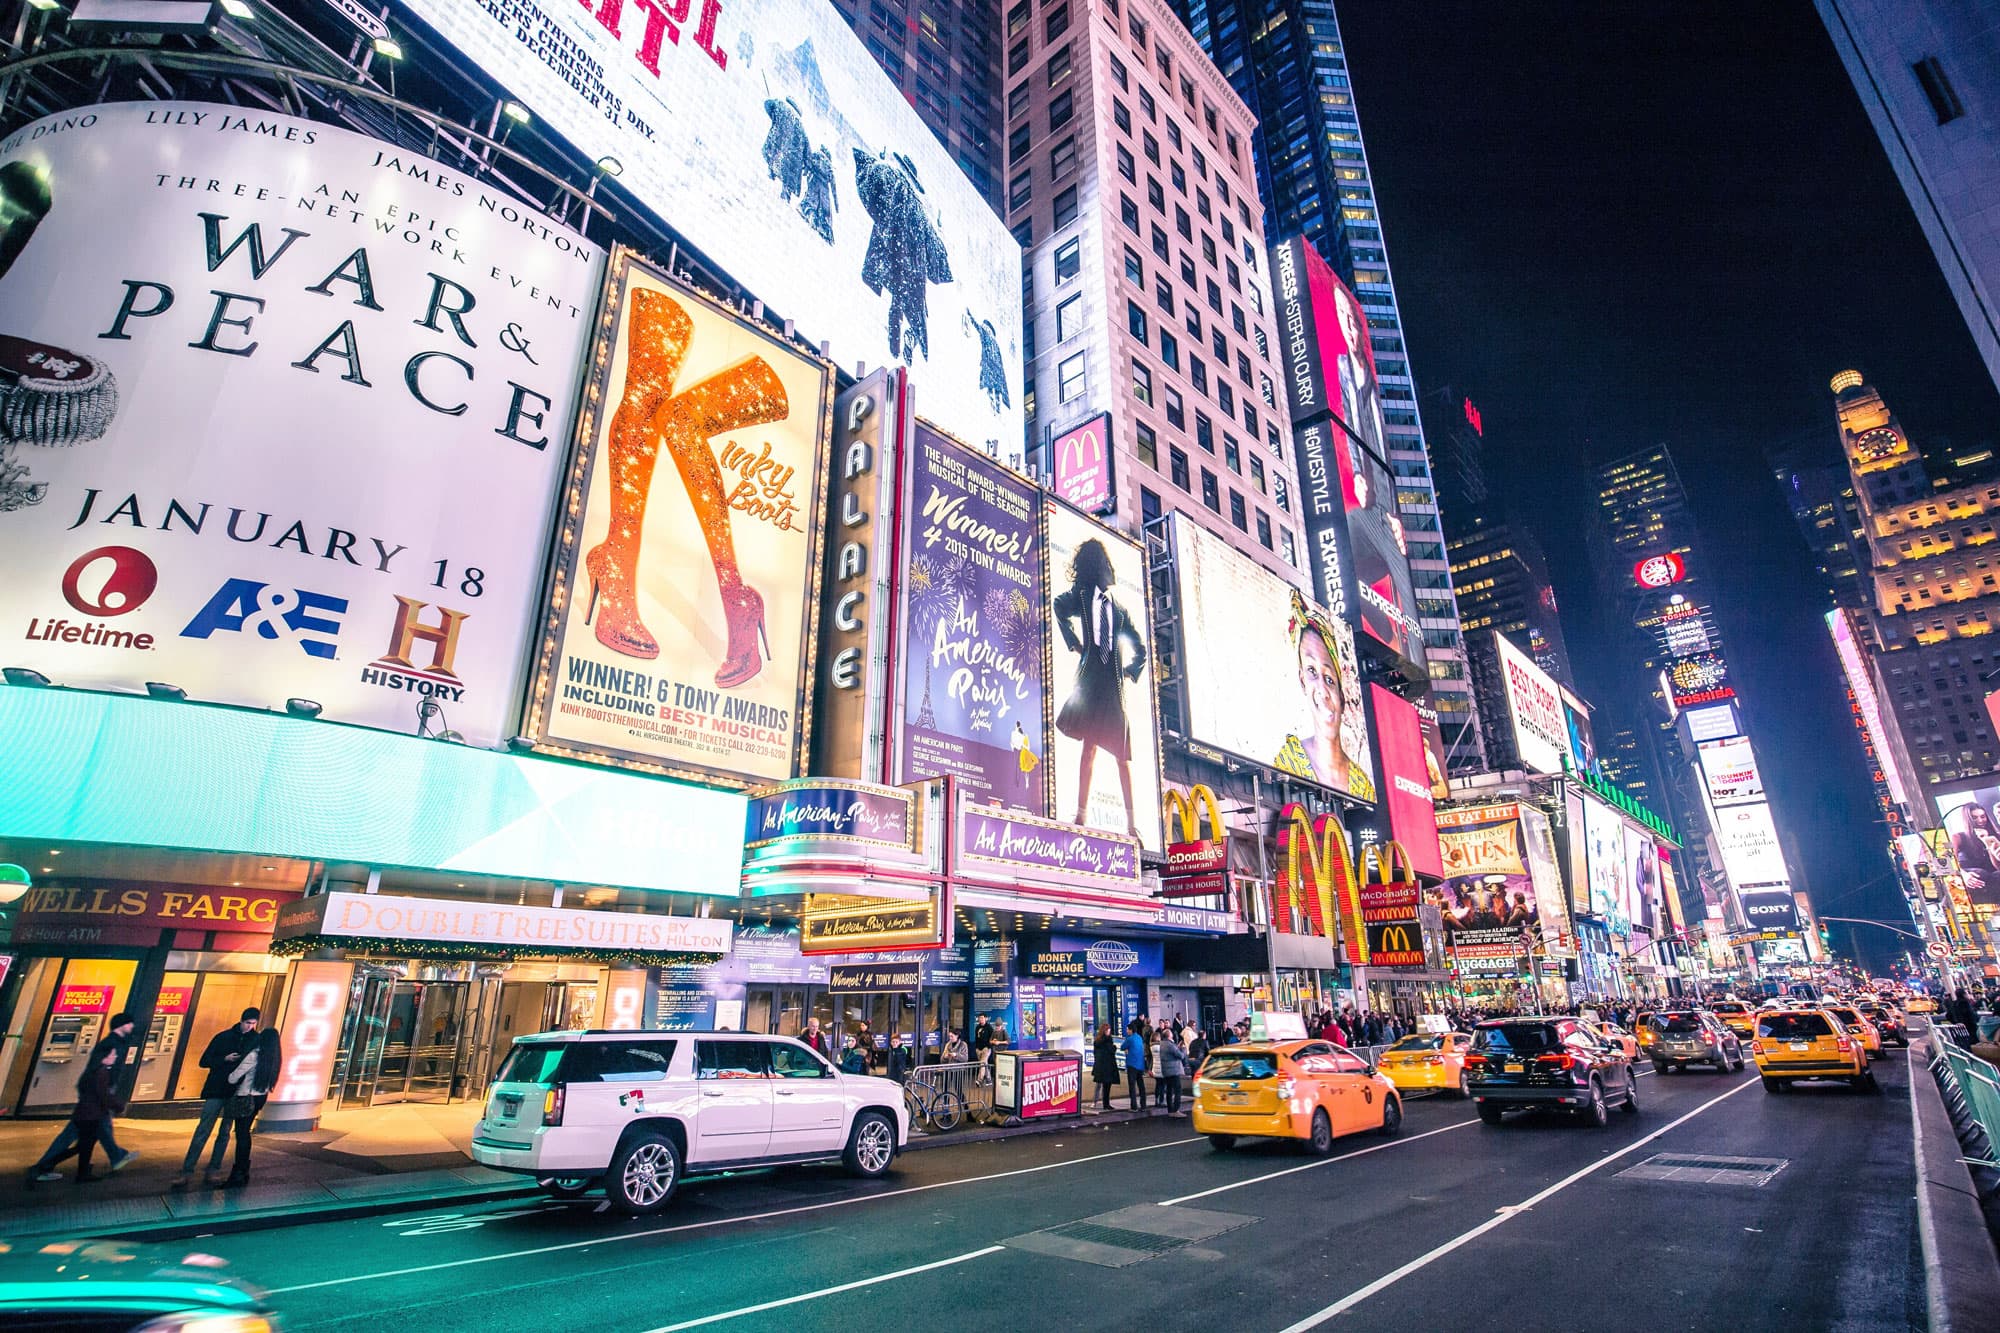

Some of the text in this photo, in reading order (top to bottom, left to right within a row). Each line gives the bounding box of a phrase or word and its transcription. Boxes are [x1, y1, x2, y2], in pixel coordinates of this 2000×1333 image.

[515, 26, 600, 110] DECEMBER
[538, 29, 657, 144] CHRISTMAS DAY.
[32, 114, 98, 140] DANO
[145, 110, 318, 145] LILY JAMES
[314, 183, 462, 242] AN EPIC
[371, 150, 592, 264] JAMES NORTON
[196, 211, 541, 367] WAR &
[490, 266, 583, 319] EVENT
[97, 278, 552, 452] PEACE
[923, 444, 941, 464] THE
[942, 454, 967, 476] MOST
[1063, 465, 1099, 489] OPEN
[928, 459, 1029, 523] MUSICAL OF THE SEASON!
[1067, 478, 1097, 502] 24
[830, 392, 876, 690] PALACE
[922, 484, 1033, 565] Winner!
[67, 487, 488, 598] JANUARY 18
[922, 526, 1033, 590] 4 2015 TONY AWARDS
[1317, 527, 1346, 620] EXPRESS
[179, 577, 350, 661] A&E
[950, 595, 980, 638] An
[1661, 607, 1699, 623] TOSHIBA
[25, 616, 156, 652] Lifetime
[931, 617, 1029, 701] American
[360, 666, 465, 703] HISTORY
[567, 655, 790, 732] WINNER! 6 TONY AWARDS
[947, 667, 1012, 719] Paris
[1674, 686, 1736, 706] TOSHIBA
[563, 684, 788, 747] INCLUDING BEST MUSICAL
[1847, 688, 1874, 757] ERNST
[683, 729, 699, 741] FOR
[699, 732, 728, 747] TICKETS
[727, 737, 744, 750] CALL
[1713, 788, 1737, 796] HOT
[762, 799, 880, 833] An American Paris
[1457, 810, 1482, 824] FAT
[1484, 806, 1516, 819] HIT!
[973, 820, 996, 852] An
[998, 821, 1067, 868] American
[1069, 836, 1103, 871] Paris
[1167, 848, 1224, 865] cDonald's
[1169, 861, 1213, 872] Restaurant
[1195, 879, 1222, 890] HOURS
[1360, 888, 1416, 901] McDonald's
[22, 886, 149, 916] WELLS
[157, 891, 278, 923] FARG
[1151, 909, 1226, 929] GE MONEY ATM
[1748, 904, 1790, 915] SONY
[67, 927, 102, 942] ATM
[665, 934, 723, 948] HILTON
[667, 922, 690, 936] BY
[1031, 963, 1085, 973] EXCHANGE
[1037, 952, 1073, 963] MONEY
[1451, 958, 1515, 970] LUGGAGE
[65, 991, 104, 999] WELLS
[157, 992, 182, 1000] ELLS
[875, 973, 892, 986] TONY
[891, 972, 919, 986] AWARDS
[63, 998, 101, 1006] FARGO
[1022, 1076, 1056, 1107] JERSEY
[1057, 1070, 1079, 1096] BOYS
